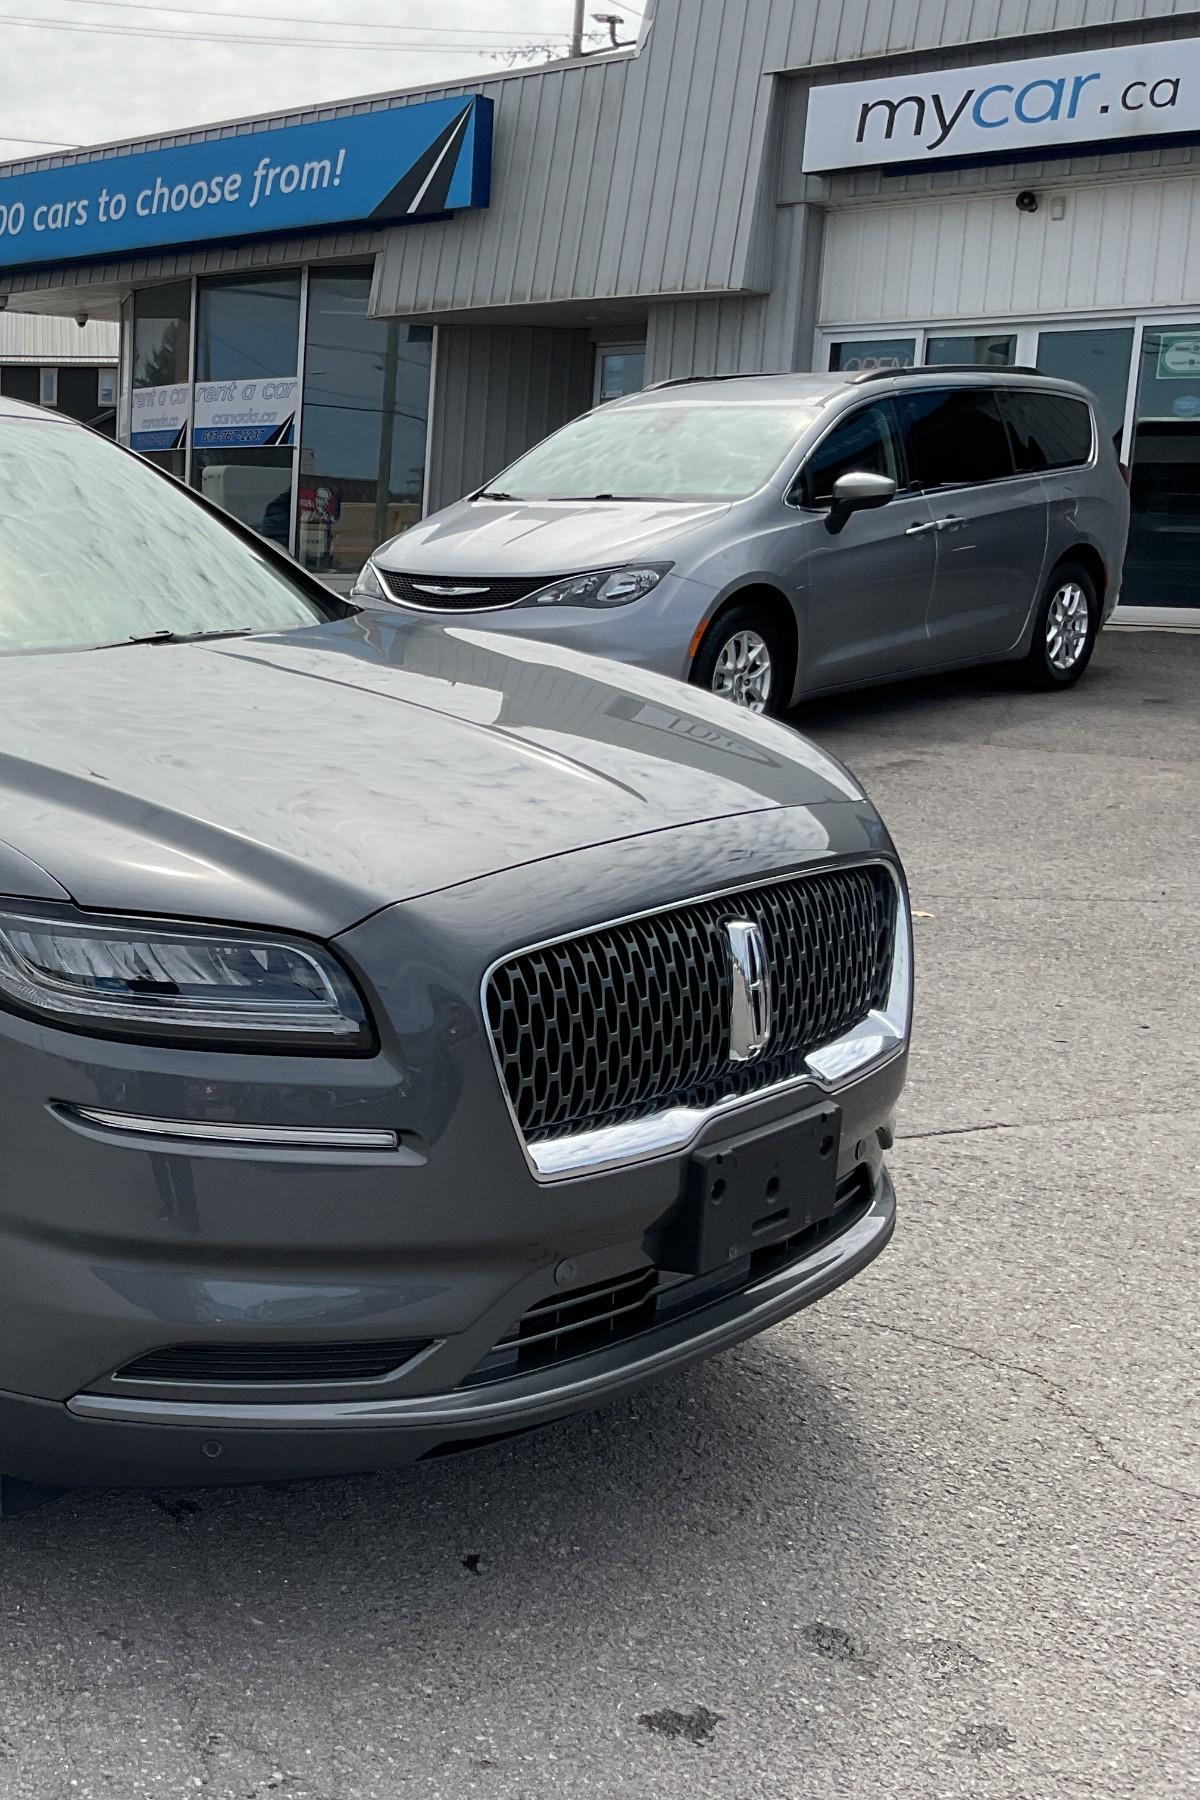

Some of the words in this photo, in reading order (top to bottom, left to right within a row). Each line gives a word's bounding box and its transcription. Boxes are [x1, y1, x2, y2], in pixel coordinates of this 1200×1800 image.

[855, 73, 1181, 151] mycar.ca
[32, 198, 89, 232] cars
[98, 188, 127, 223] to
[135, 173, 242, 217] choose
[249, 148, 347, 208] from!
[195, 382, 237, 403] rent
[241, 383, 257, 401] a
[263, 381, 298, 400] car
[211, 408, 278, 425] canada.ca
